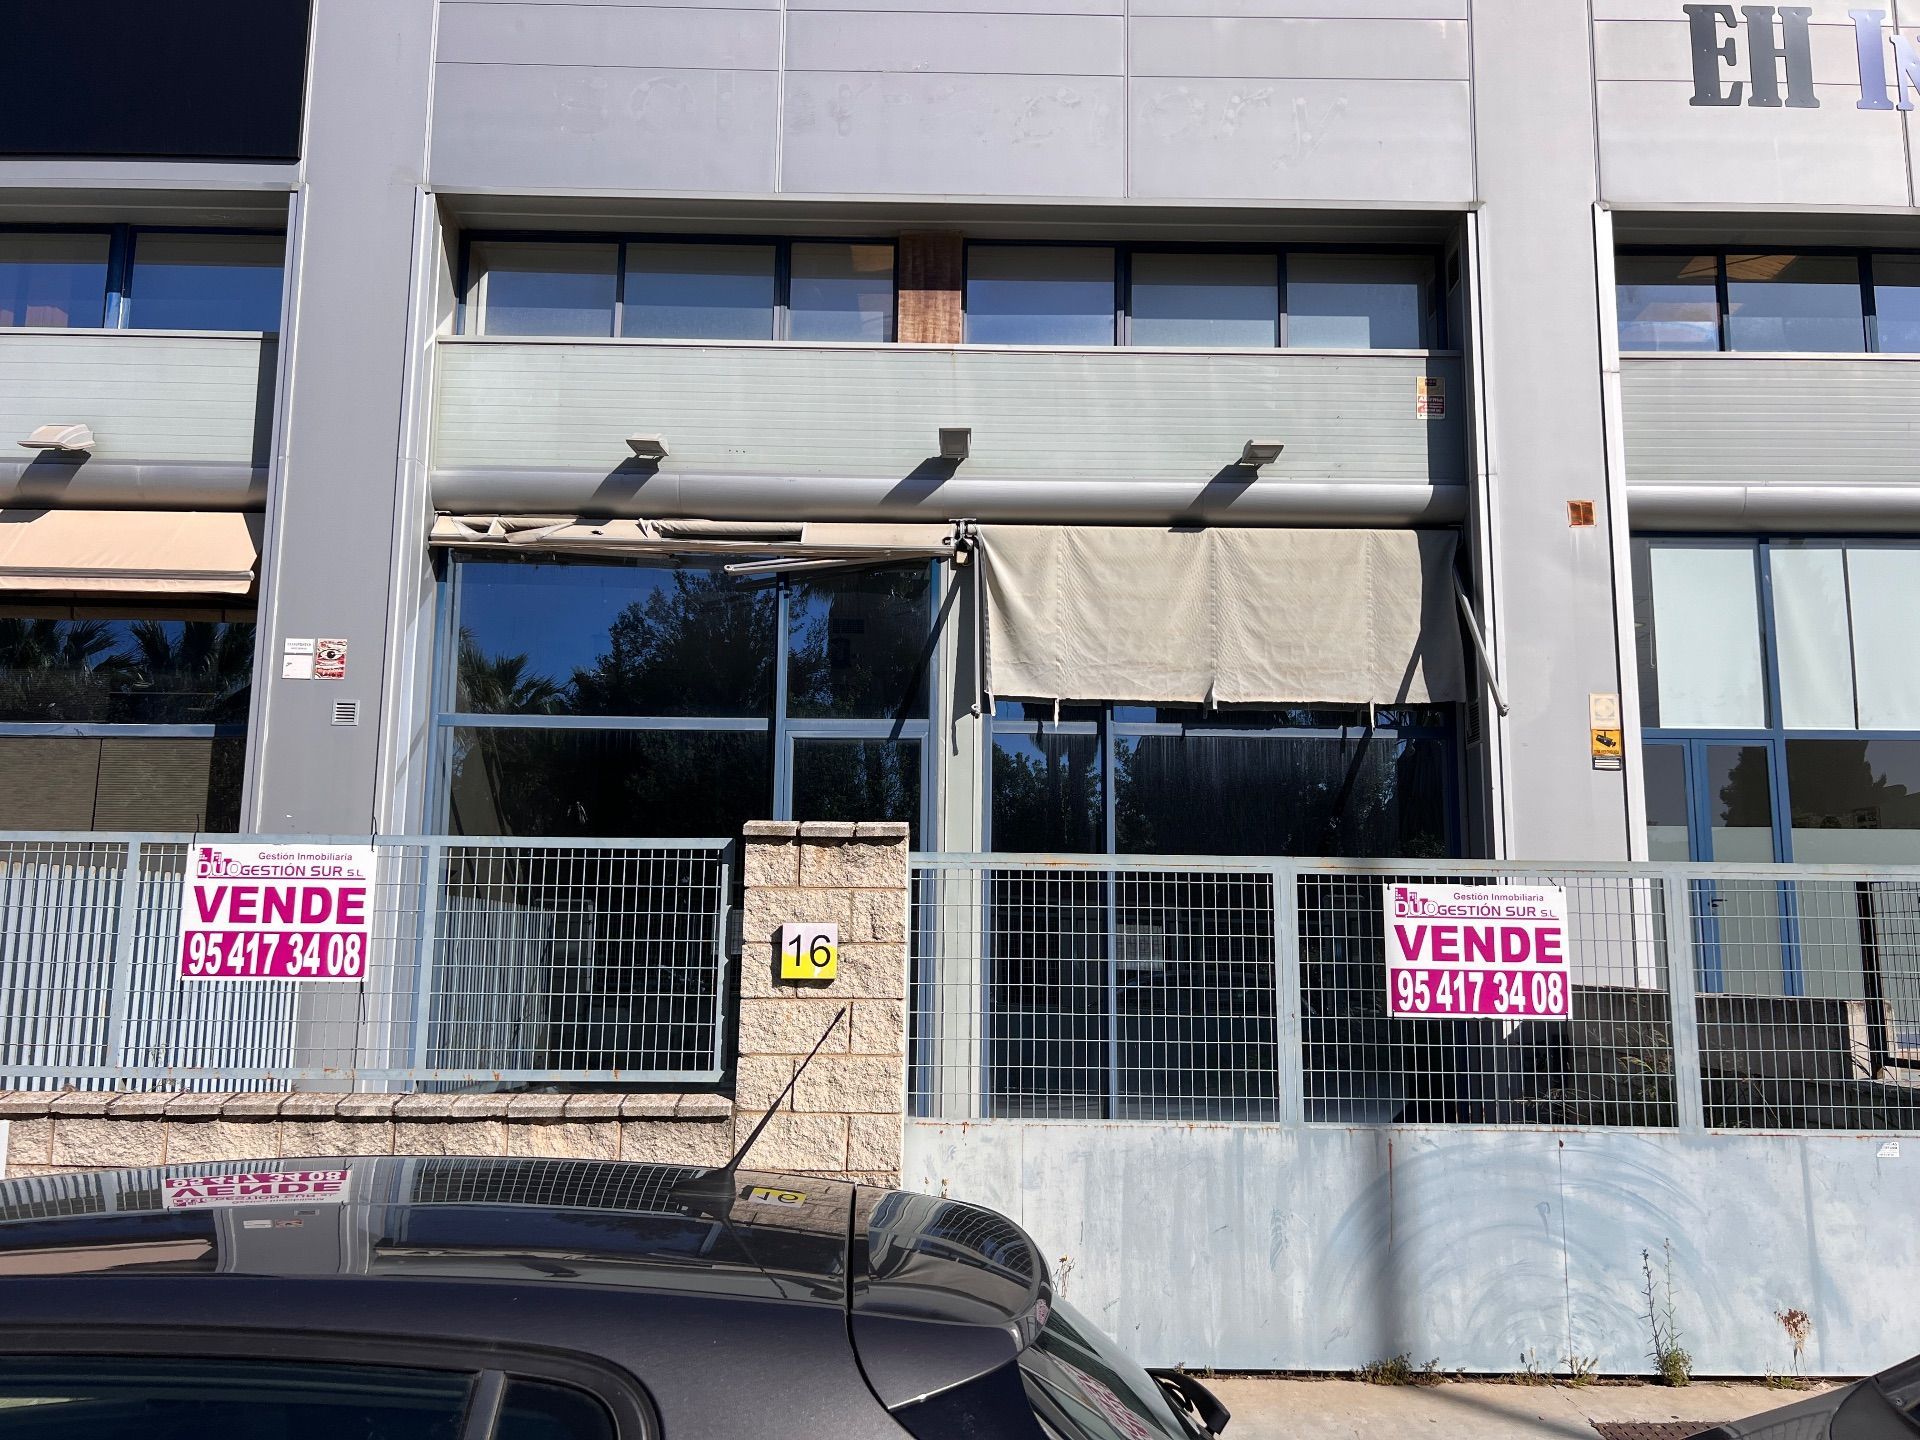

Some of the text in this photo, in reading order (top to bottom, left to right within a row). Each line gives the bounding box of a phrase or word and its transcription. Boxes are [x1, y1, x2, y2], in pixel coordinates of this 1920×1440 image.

[1682, 4, 1820, 108] EH
[258, 852, 353, 861] Gestión Inmobiliaria
[310, 866, 342, 877] SUR
[193, 885, 367, 925] VENDE
[1453, 892, 1544, 902] Gestión Inmobiliaria
[1506, 906, 1536, 917] SUR
[189, 933, 361, 976] 95 417 34 08
[788, 934, 830, 967] 16
[1394, 925, 1563, 963] VENDE
[1397, 970, 1564, 1014] 95 417 34 08
